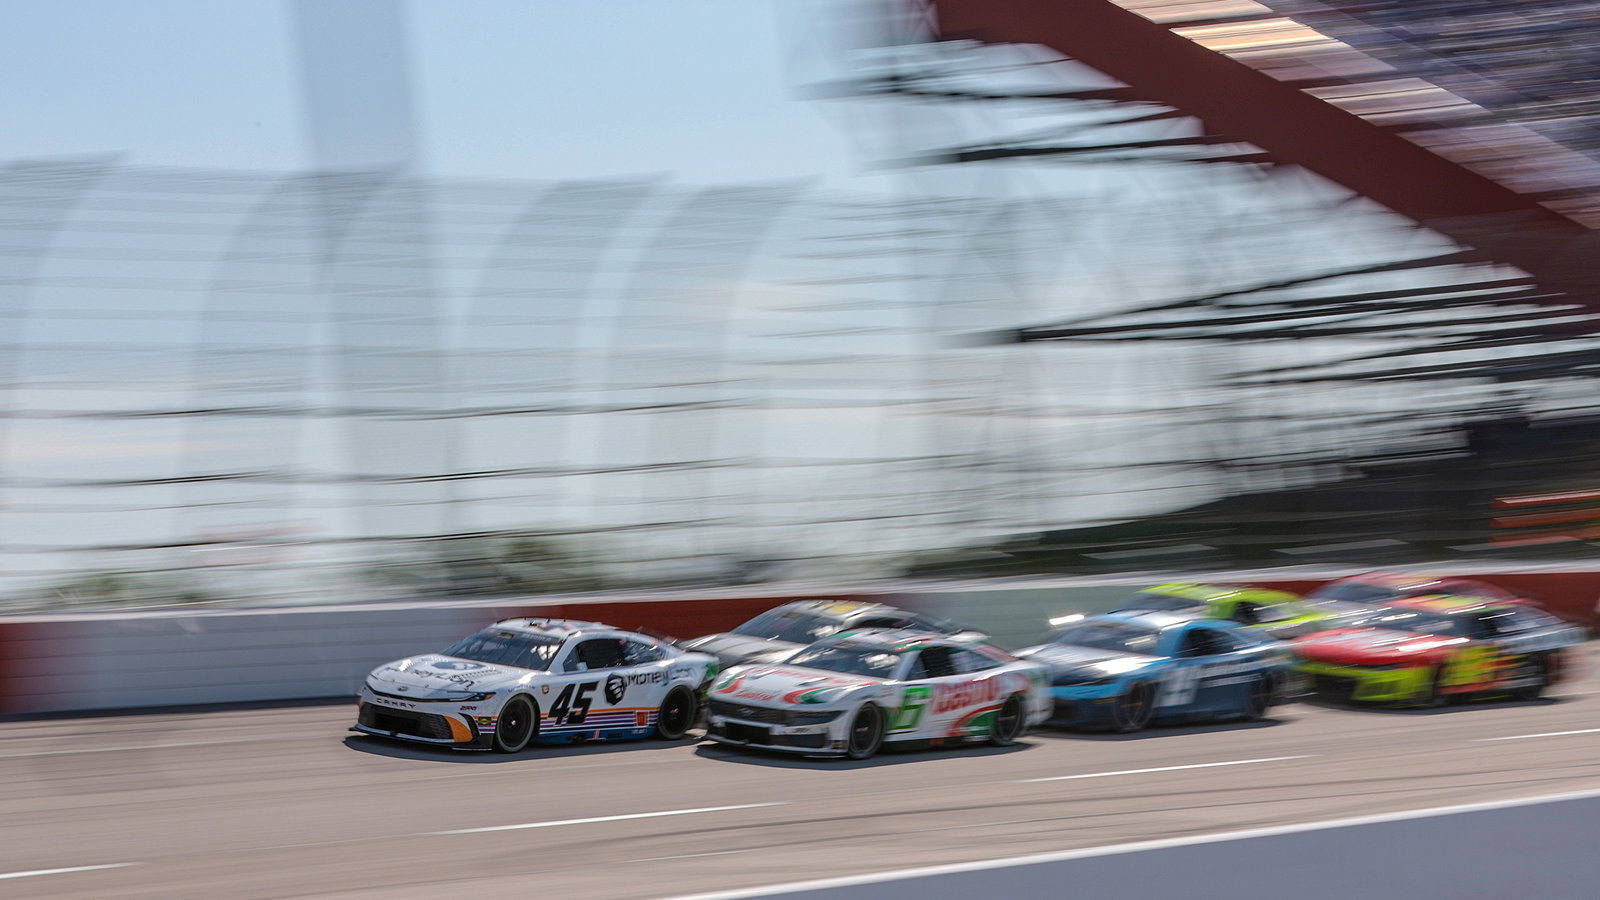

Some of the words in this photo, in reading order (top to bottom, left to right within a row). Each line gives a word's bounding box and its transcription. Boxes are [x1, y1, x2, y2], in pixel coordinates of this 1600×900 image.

[376, 697, 416, 709] CAMRY
[548, 681, 599, 726] 45
[892, 686, 932, 730] 6
